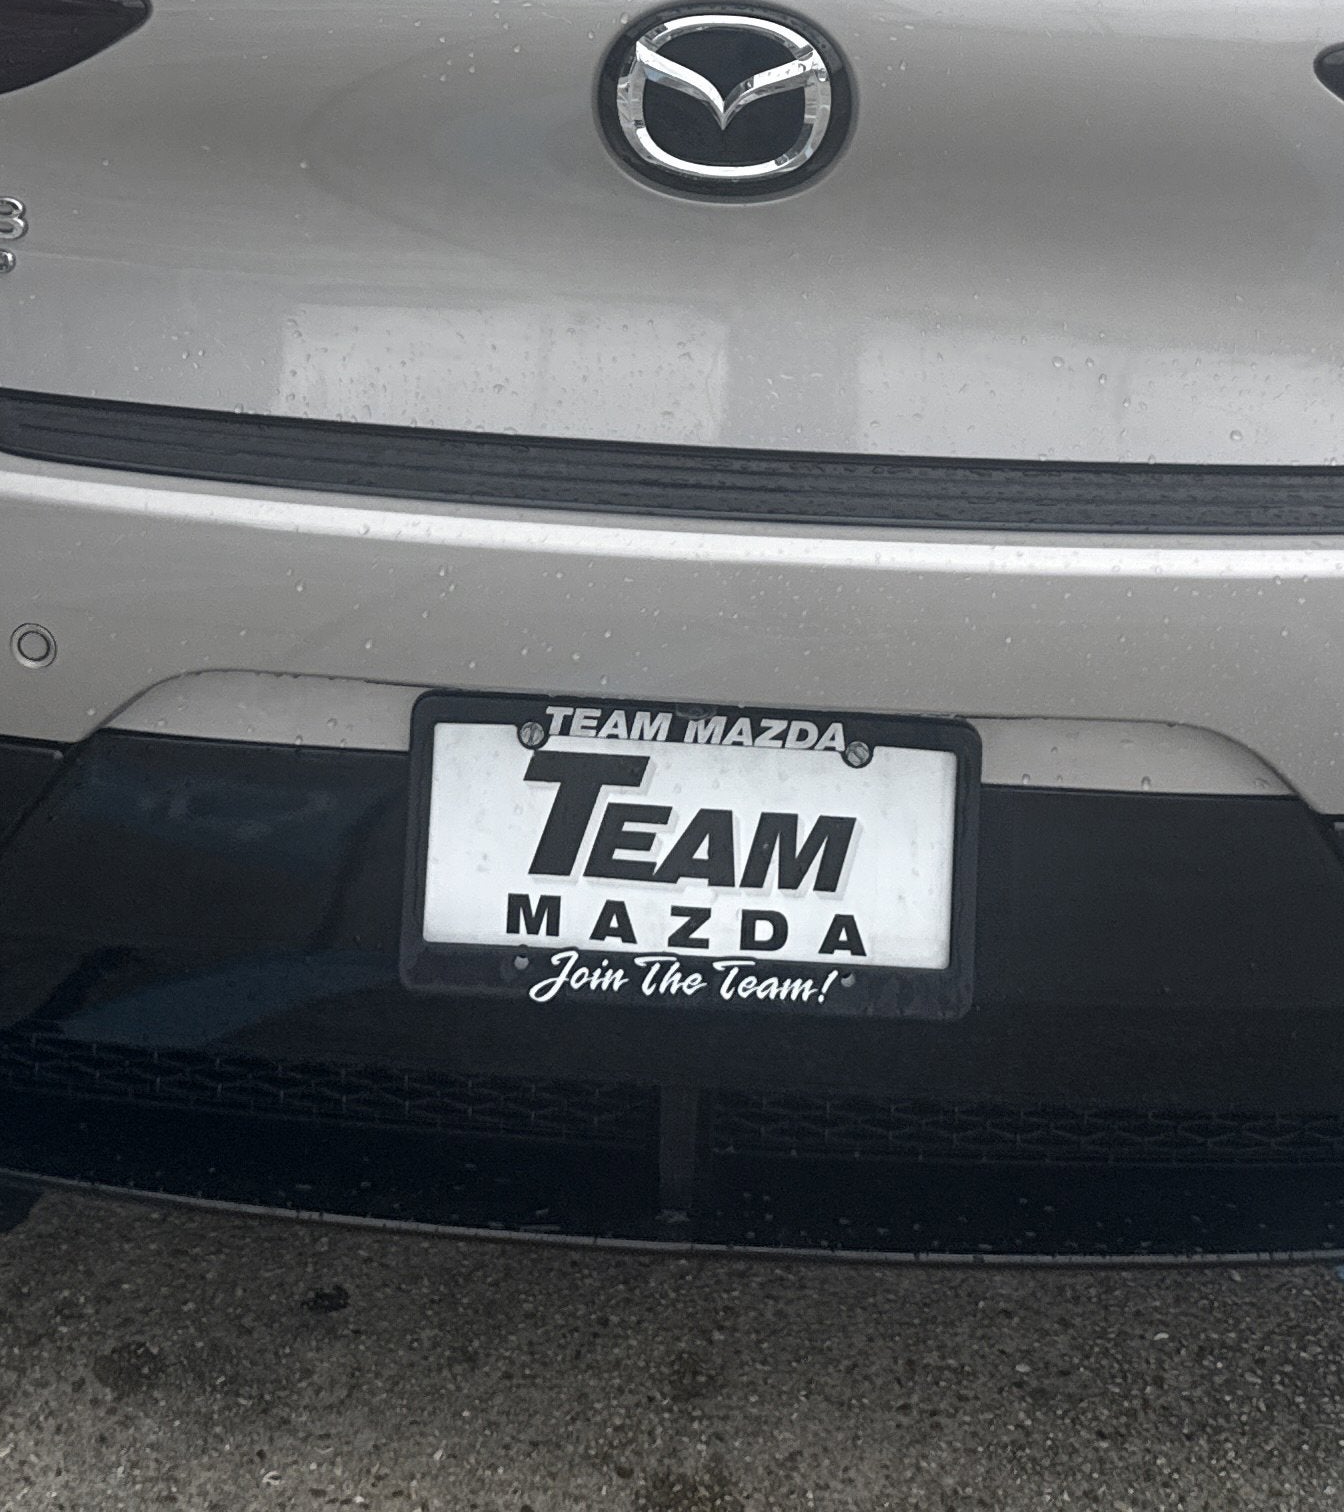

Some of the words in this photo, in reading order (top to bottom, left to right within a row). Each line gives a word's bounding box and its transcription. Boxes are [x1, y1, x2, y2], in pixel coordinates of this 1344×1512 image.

[545, 706, 673, 742] TEAM
[683, 715, 846, 751] MAZDA
[523, 749, 858, 893] TEAM
[506, 893, 867, 956] MAZDA
[529, 950, 629, 1002] Join
[634, 955, 707, 996] The
[712, 959, 839, 1003] Team!
